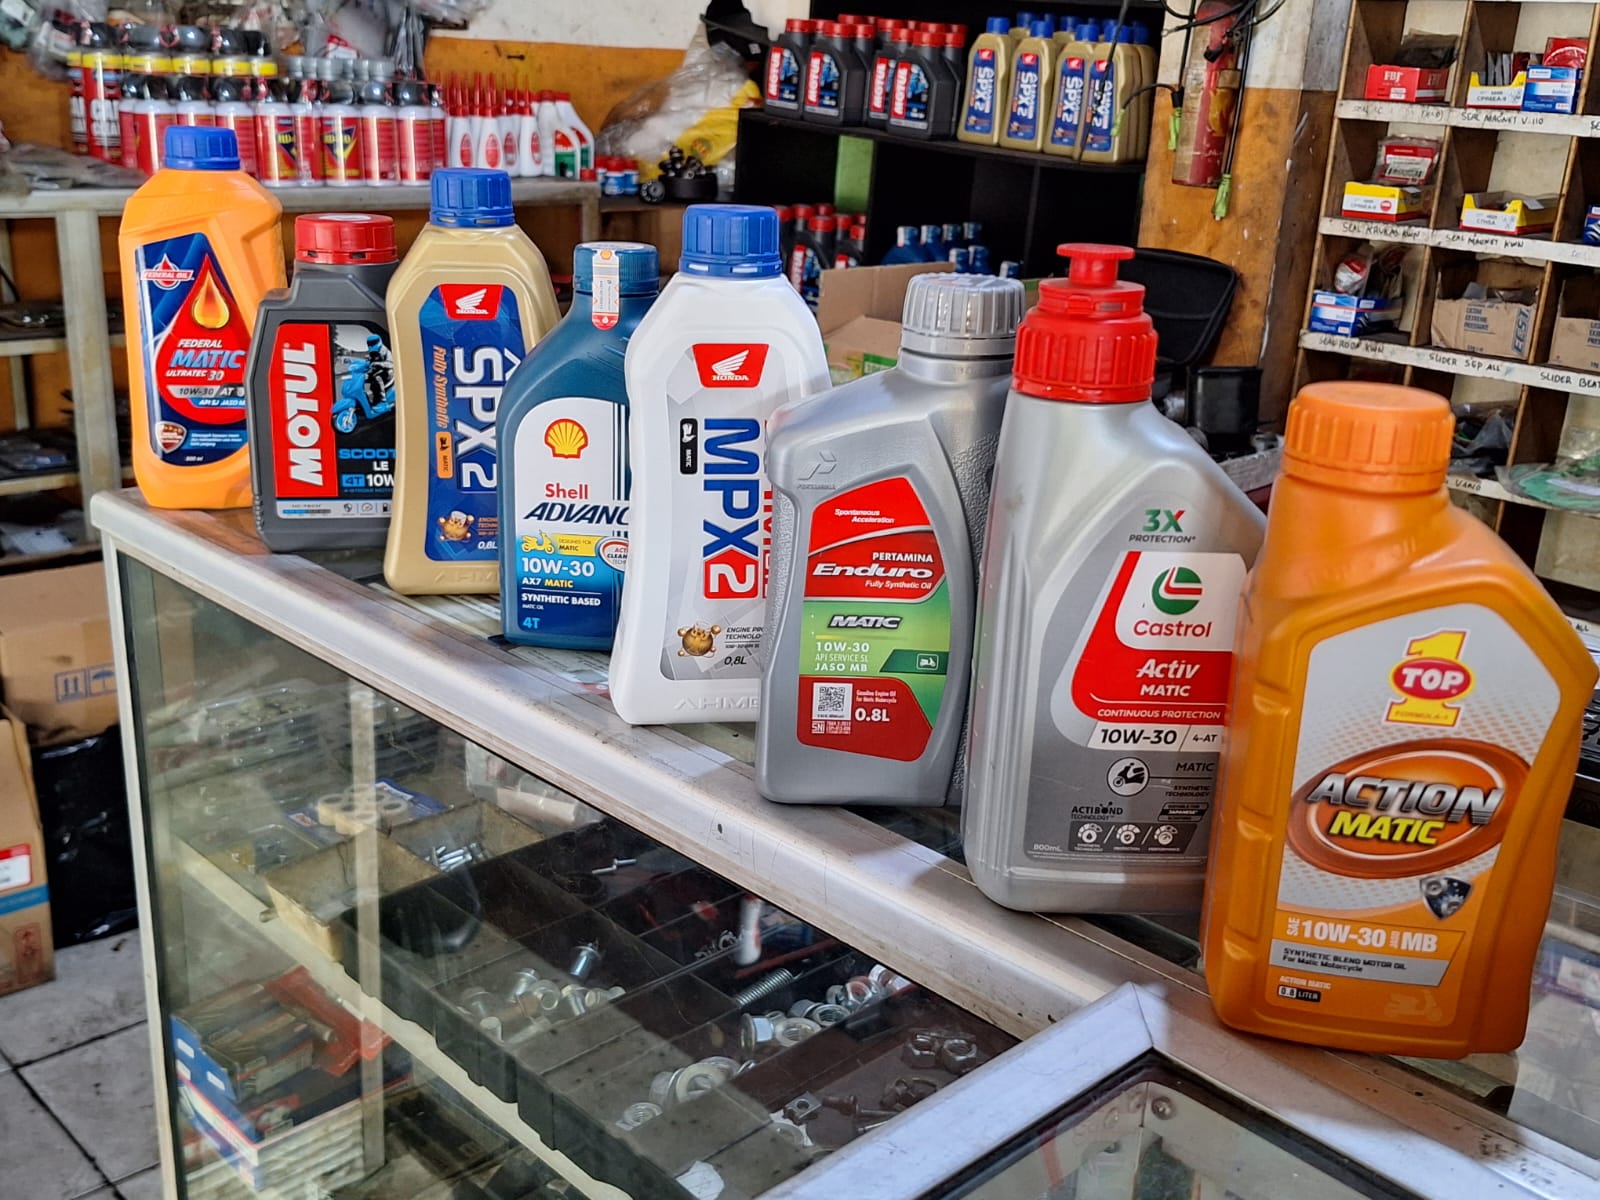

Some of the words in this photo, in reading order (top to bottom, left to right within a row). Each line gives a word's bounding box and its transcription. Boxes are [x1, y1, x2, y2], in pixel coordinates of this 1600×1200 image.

[145, 271, 175, 279] FEDERAL
[177, 339, 222, 348] FEDERAL
[170, 350, 245, 368] MATIC
[1429, 352, 1457, 366] SLIDER
[208, 371, 224, 381] 30
[1540, 372, 1572, 385] SLIDER
[179, 387, 214, 395] 10W-30
[282, 342, 324, 487] MOTUL
[545, 482, 588, 500] Shell
[702, 418, 760, 594] MPX2
[834, 508, 880, 517] Spontaneous
[852, 516, 895, 524] Acceleration
[1142, 509, 1186, 532] 3X
[872, 552, 934, 563] PERTAMINA
[521, 557, 595, 577] 10W-30
[812, 563, 934, 579] Enduro
[522, 577, 541, 585] AX7
[544, 579, 574, 588] MATIC
[865, 580, 884, 589] Fully
[885, 581, 920, 589] Synthetic
[920, 582, 932, 590] Oil
[521, 593, 569, 604] SYNTHETIC
[571, 597, 601, 606] BASED
[523, 617, 540, 629] 4T
[829, 615, 901, 628] MATIC
[1133, 619, 1212, 638] Castrol
[816, 642, 870, 652] 10W-30
[724, 656, 747, 667] 0,8L
[829, 654, 858, 662] SERVICE
[815, 663, 845, 671] JASO
[850, 664, 868, 672] MB
[1136, 658, 1200, 679] Activ
[1402, 668, 1465, 691] TOP
[1140, 684, 1191, 696] MATIC
[855, 707, 890, 721] 0.8L
[1097, 708, 1160, 718] CONTINUOUS
[1161, 710, 1221, 719] PROTECTION
[1101, 729, 1177, 745] 10W-30
[1192, 734, 1218, 743] 4-AT
[1175, 762, 1215, 772] MATIC
[1307, 772, 1505, 825] ACTION
[1071, 803, 1124, 815] ACTIBOND
[1329, 811, 1445, 844] MATIC
[1286, 917, 1300, 937] SAE
[1301, 919, 1386, 948] 10W-30
[1401, 932, 1438, 953] MB
[1283, 954, 1295, 963] For
[1297, 957, 1319, 967] Matic
[1321, 961, 1363, 973] Motorcycle
[1284, 948, 1330, 961] SYNTHETIC
[1333, 954, 1361, 965] BLEND
[1363, 959, 1392, 969] MOTOR
[1279, 976, 1307, 986] ACTION
[1308, 980, 1332, 990] MATIC
[1280, 986, 1296, 997] 0.8
[1298, 990, 1319, 1000] LITER
